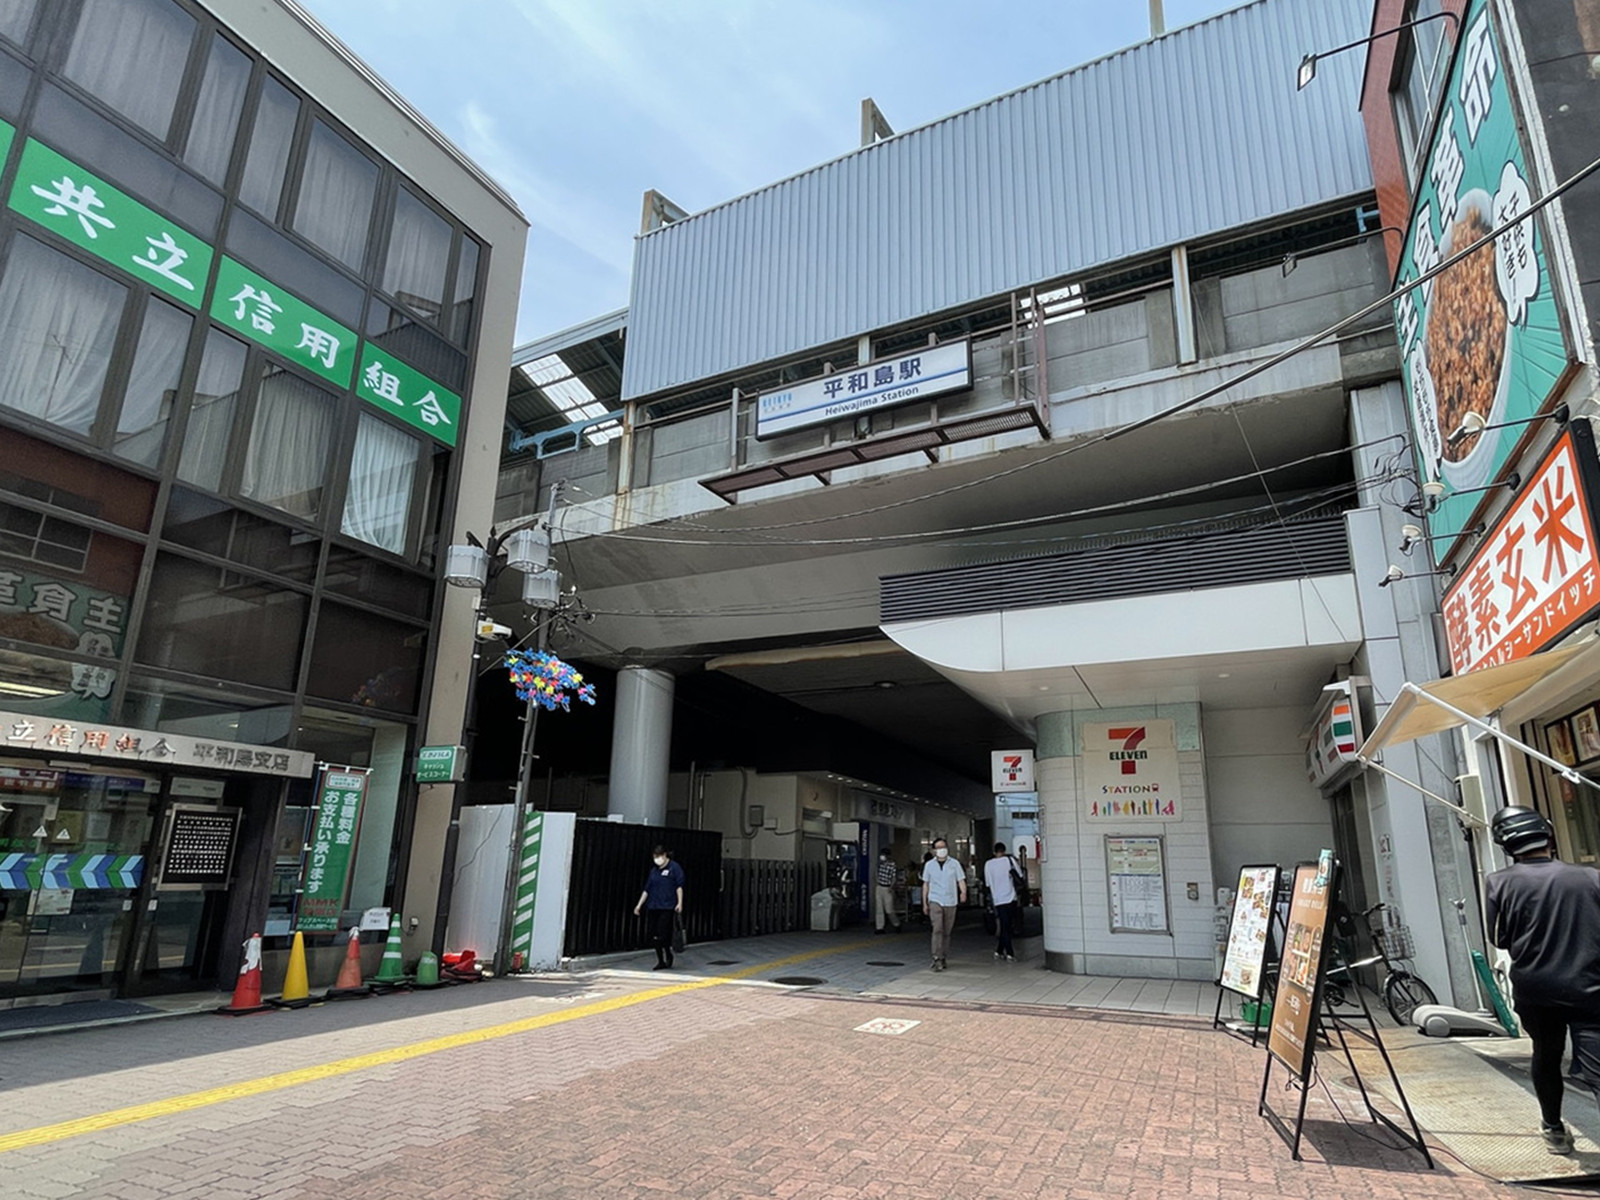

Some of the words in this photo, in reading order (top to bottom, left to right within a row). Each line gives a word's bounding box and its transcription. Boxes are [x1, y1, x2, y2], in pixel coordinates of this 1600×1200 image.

[1399, 8, 1497, 359] 主食革命
[30, 175, 452, 426] 共立信用組合
[823, 357, 921, 399] 平和島駅
[825, 397, 878, 416] Heiwajima
[881, 387, 919, 403] Station
[1446, 466, 1585, 672] 酵素玄米
[1476, 567, 1596, 670] ヘルシーサンドイッチ
[0, 720, 177, 758] 立信用組合
[1108, 726, 1146, 775] 7
[1003, 756, 1022, 781] 7
[1102, 784, 1151, 794] STATION
[308, 791, 341, 893] お支払い承ります
